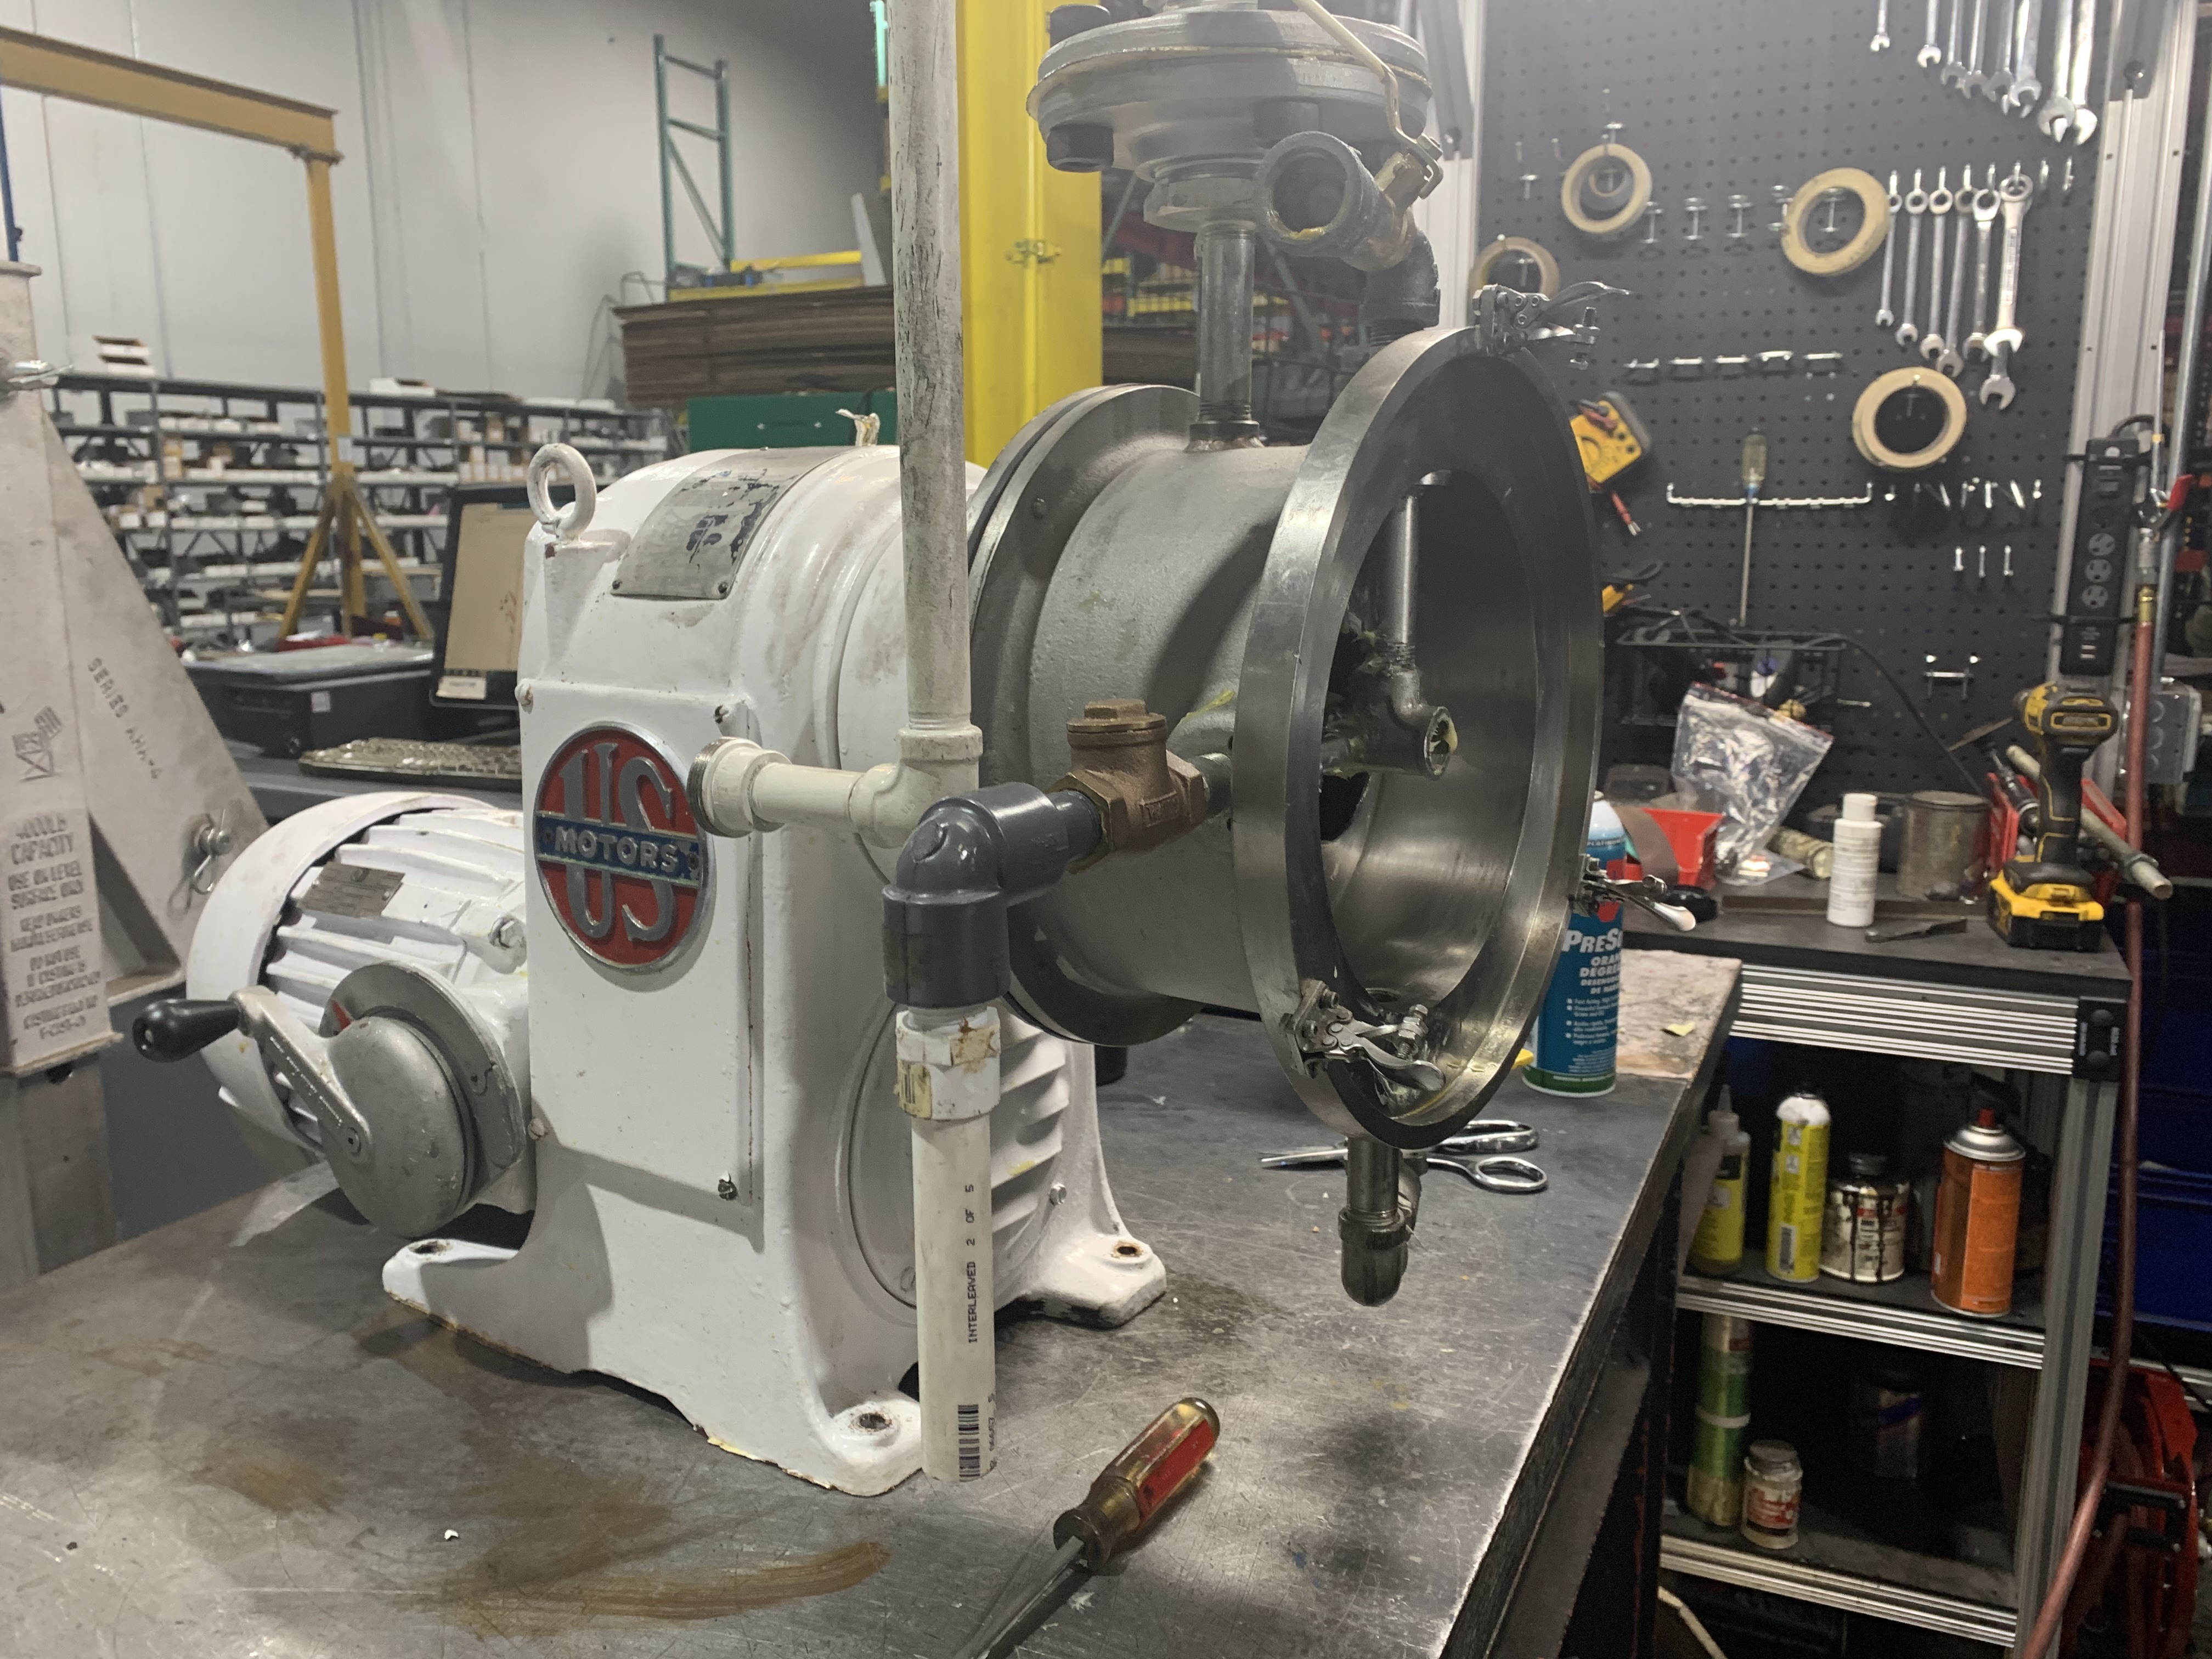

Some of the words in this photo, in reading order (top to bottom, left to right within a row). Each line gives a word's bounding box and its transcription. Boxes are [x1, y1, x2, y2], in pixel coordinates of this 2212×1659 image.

[88, 657, 129, 718] SERIES
[554, 826, 679, 872] MOTORS
[559, 742, 675, 941] US
[964, 1184, 974, 1193] 5
[965, 1208, 975, 1223] OF
[966, 1238, 975, 1246] 2
[967, 1261, 977, 1344] INTERLEAVED
